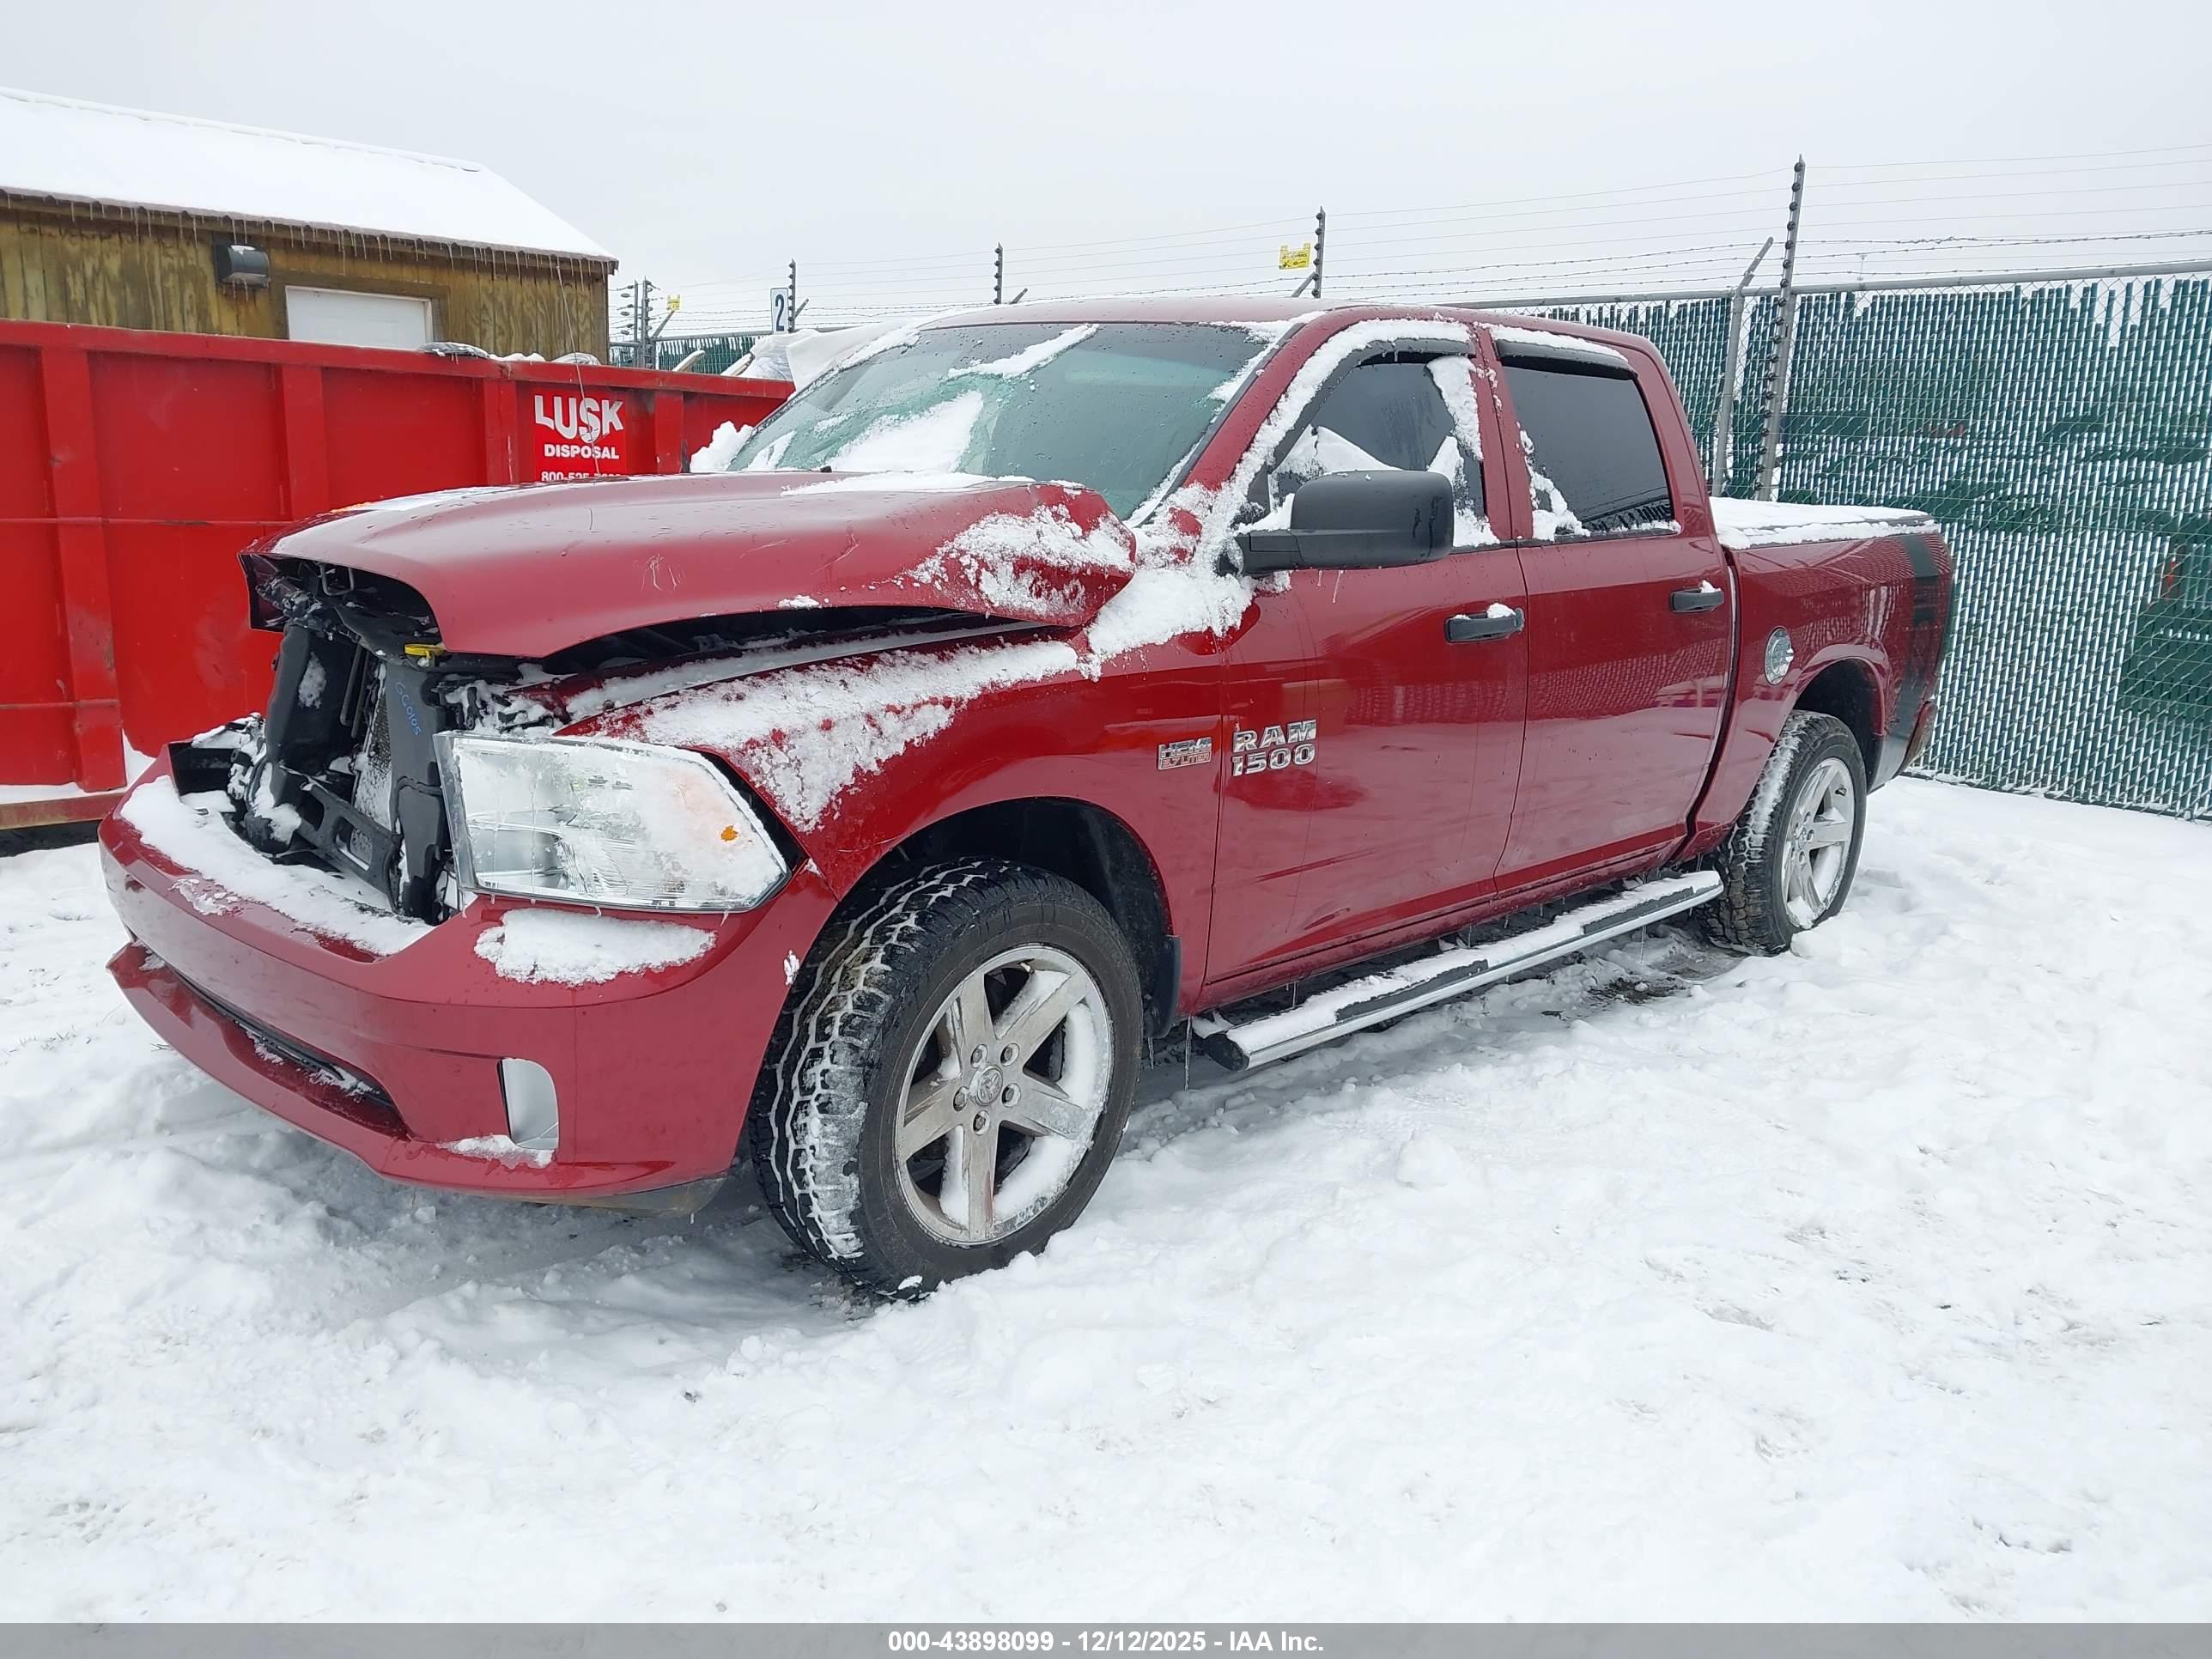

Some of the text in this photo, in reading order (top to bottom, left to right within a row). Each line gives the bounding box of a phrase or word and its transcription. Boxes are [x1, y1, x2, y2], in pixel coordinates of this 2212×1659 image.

[775, 294, 785, 331] 2
[534, 395, 624, 444] LUSK
[544, 443, 620, 459] DISPOSAL
[1233, 720, 1317, 753] RAM
[1231, 744, 1316, 777] 1500
